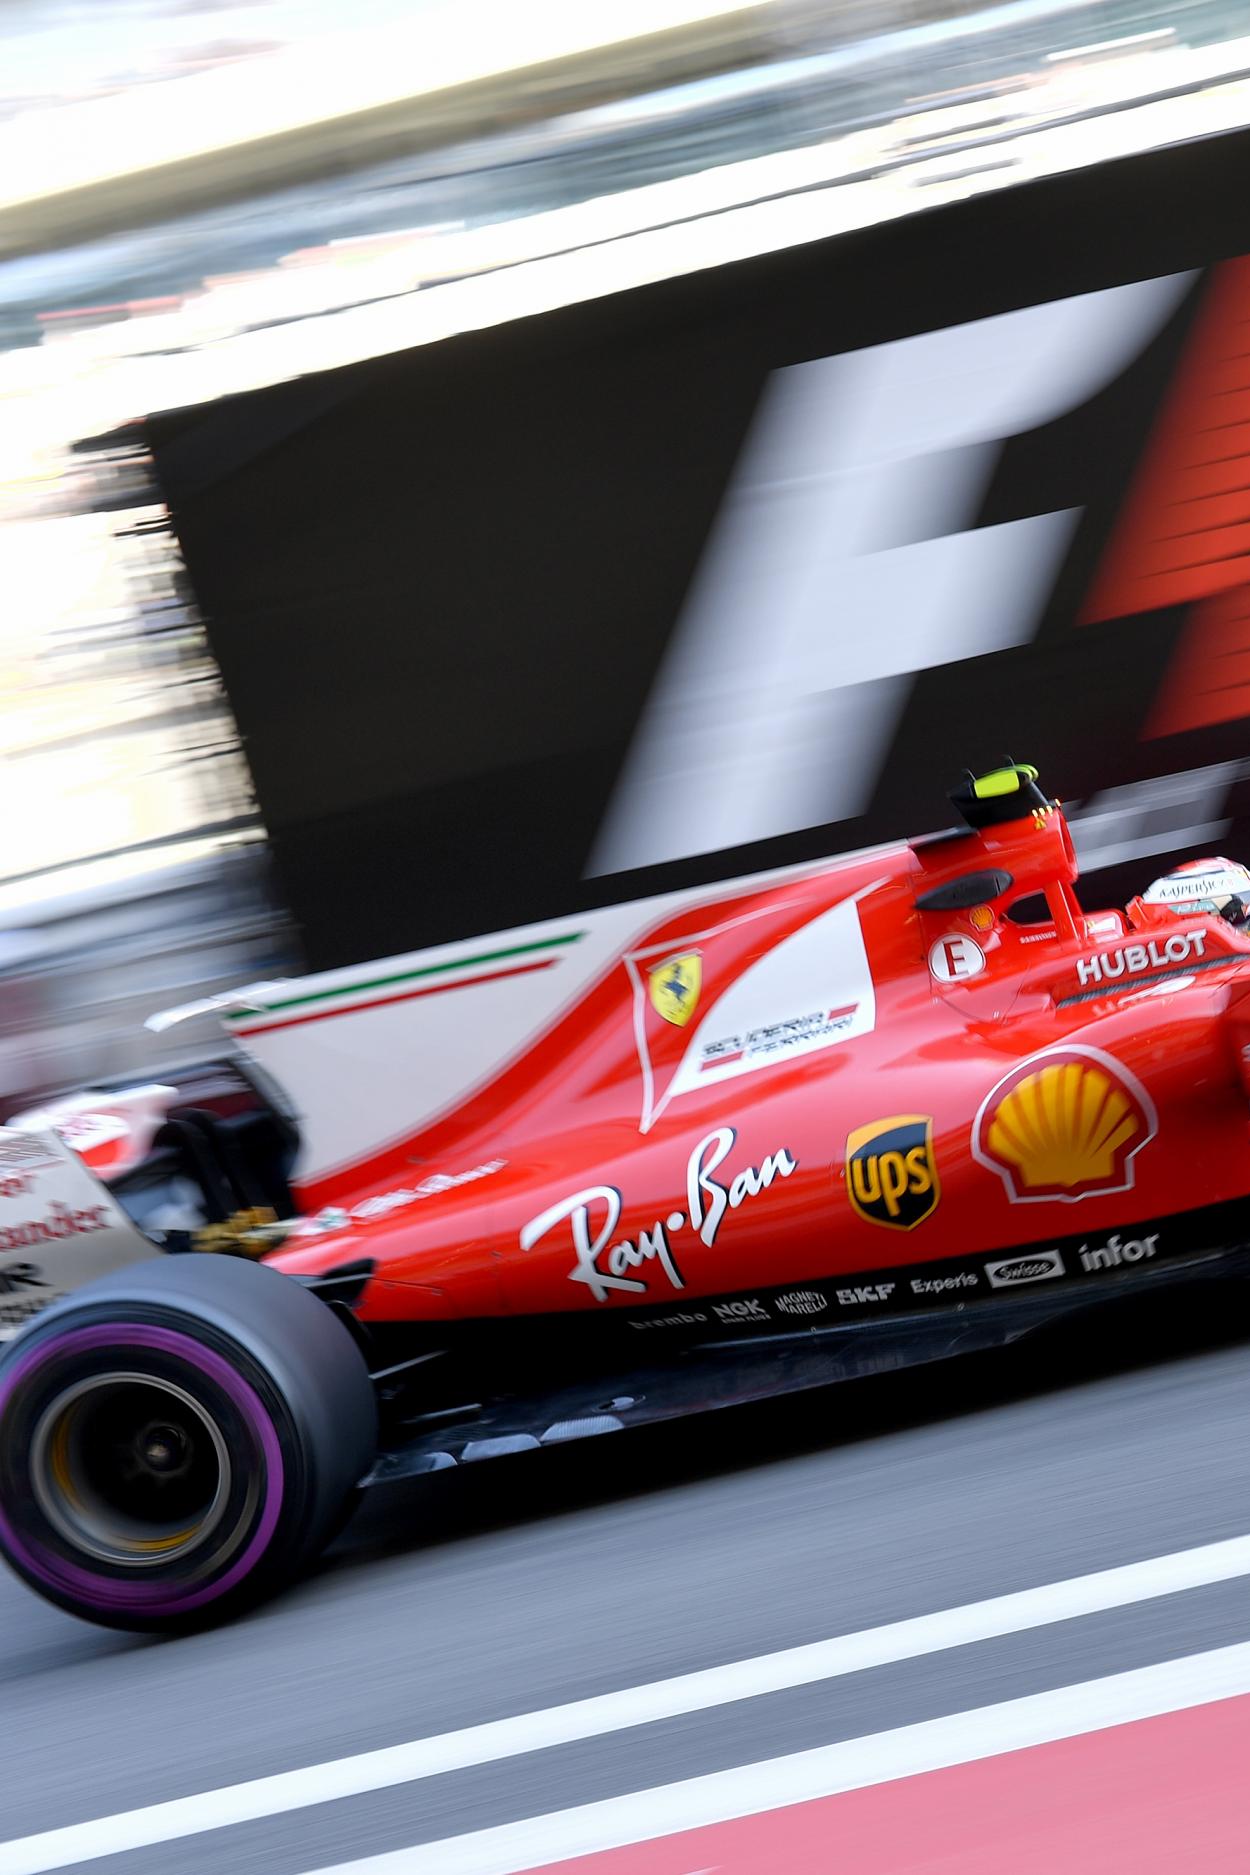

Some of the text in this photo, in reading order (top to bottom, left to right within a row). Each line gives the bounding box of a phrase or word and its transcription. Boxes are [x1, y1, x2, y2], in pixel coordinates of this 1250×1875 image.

[942, 940, 967, 977] E
[1076, 928, 1207, 985] HUBLOT
[1078, 1233, 1159, 1272] infor
[999, 1258, 1052, 1282] Swisse
[836, 1283, 895, 1305] SKF
[910, 1272, 978, 1294] Experis
[712, 1298, 767, 1319] NGK
[775, 1290, 824, 1312] MAGNETI
[628, 1311, 708, 1330] brembo
